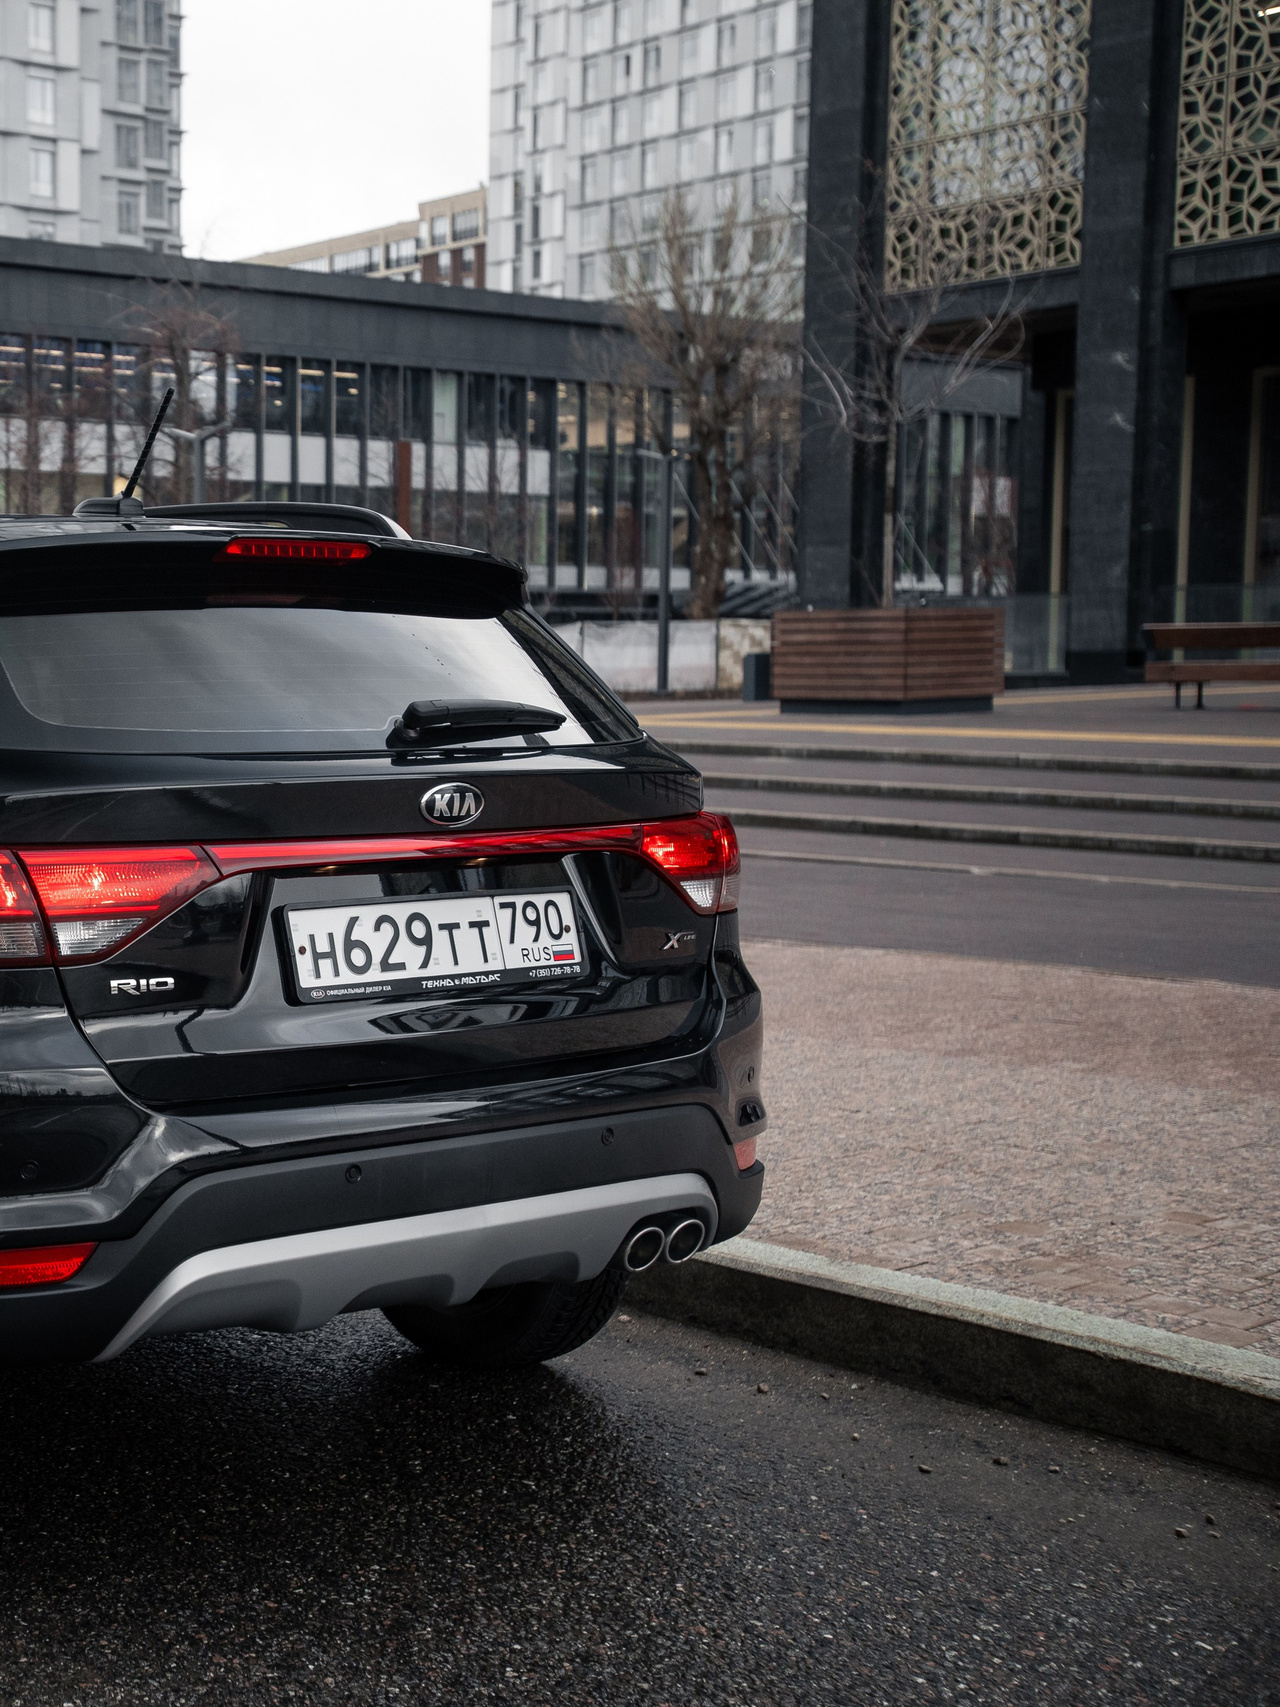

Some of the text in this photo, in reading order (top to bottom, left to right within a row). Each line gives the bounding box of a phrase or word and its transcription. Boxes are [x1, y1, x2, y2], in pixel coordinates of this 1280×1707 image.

[433, 792, 476, 817] KIA
[498, 899, 564, 945] 790
[521, 946, 552, 963] RUS
[529, 970, 536, 978] +7
[109, 976, 175, 996] RIO
[326, 986, 365, 996] ОФИЦИАЛЬНЫЙ
[365, 985, 382, 994] ДИЛЕР
